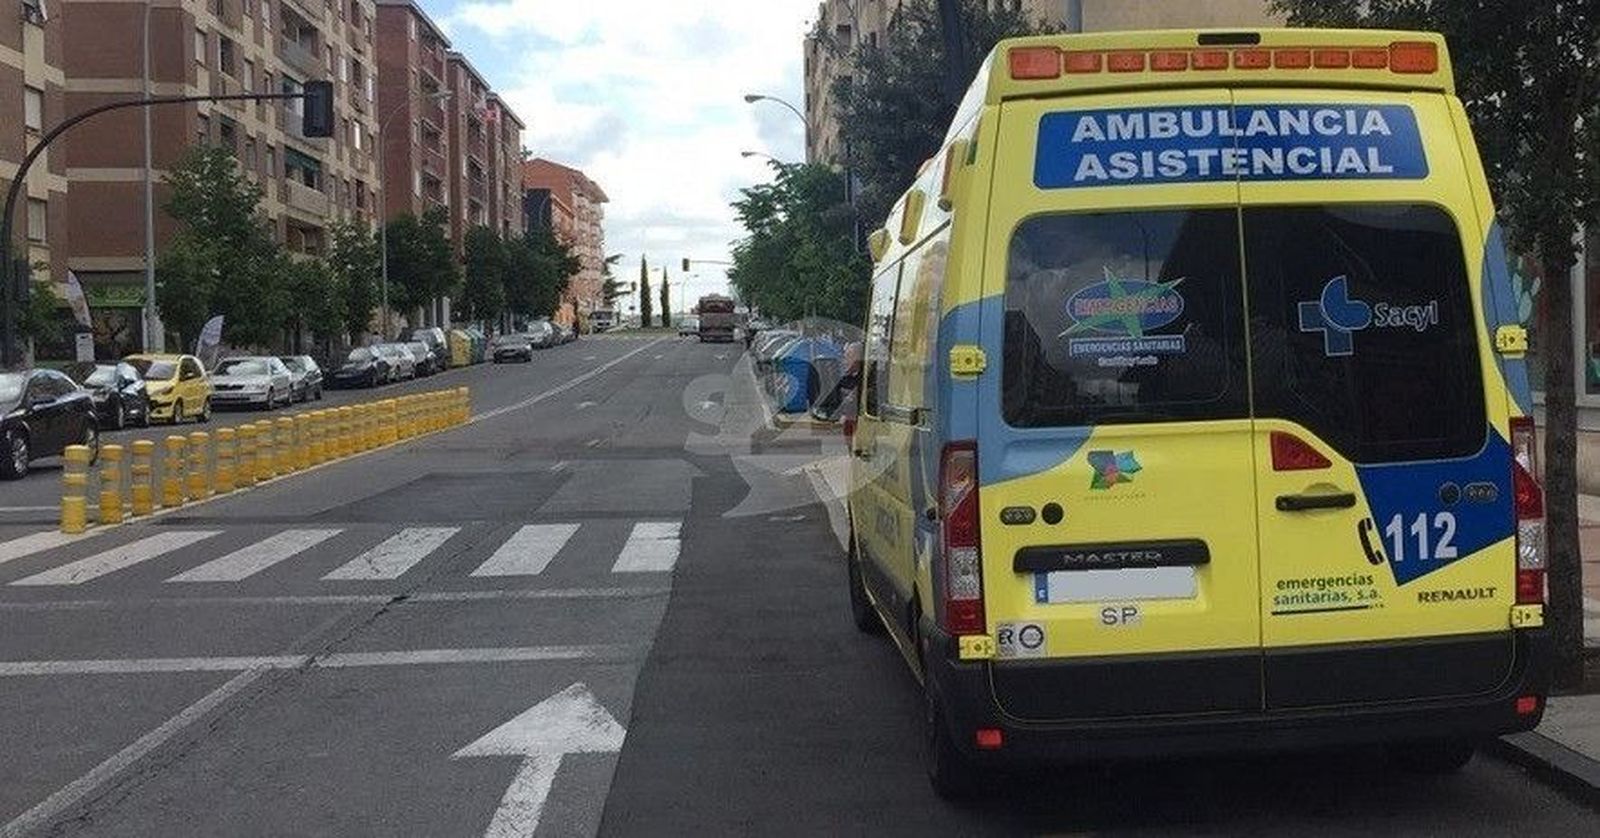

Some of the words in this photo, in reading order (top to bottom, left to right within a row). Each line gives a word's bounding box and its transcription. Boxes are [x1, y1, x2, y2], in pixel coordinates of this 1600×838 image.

[1071, 109, 1392, 143] AMBULANCIA
[1073, 146, 1394, 182] ASISTENCIAL
[1374, 300, 1439, 332] Sacyl
[1385, 510, 1458, 562] 112
[1062, 551, 1163, 565] MASTER
[1276, 573, 1374, 592] emergencias
[1273, 590, 1352, 606] sanitarias,
[1356, 588, 1383, 600] s.a.
[1417, 586, 1498, 603] RENAULT
[1101, 606, 1138, 626] SP
